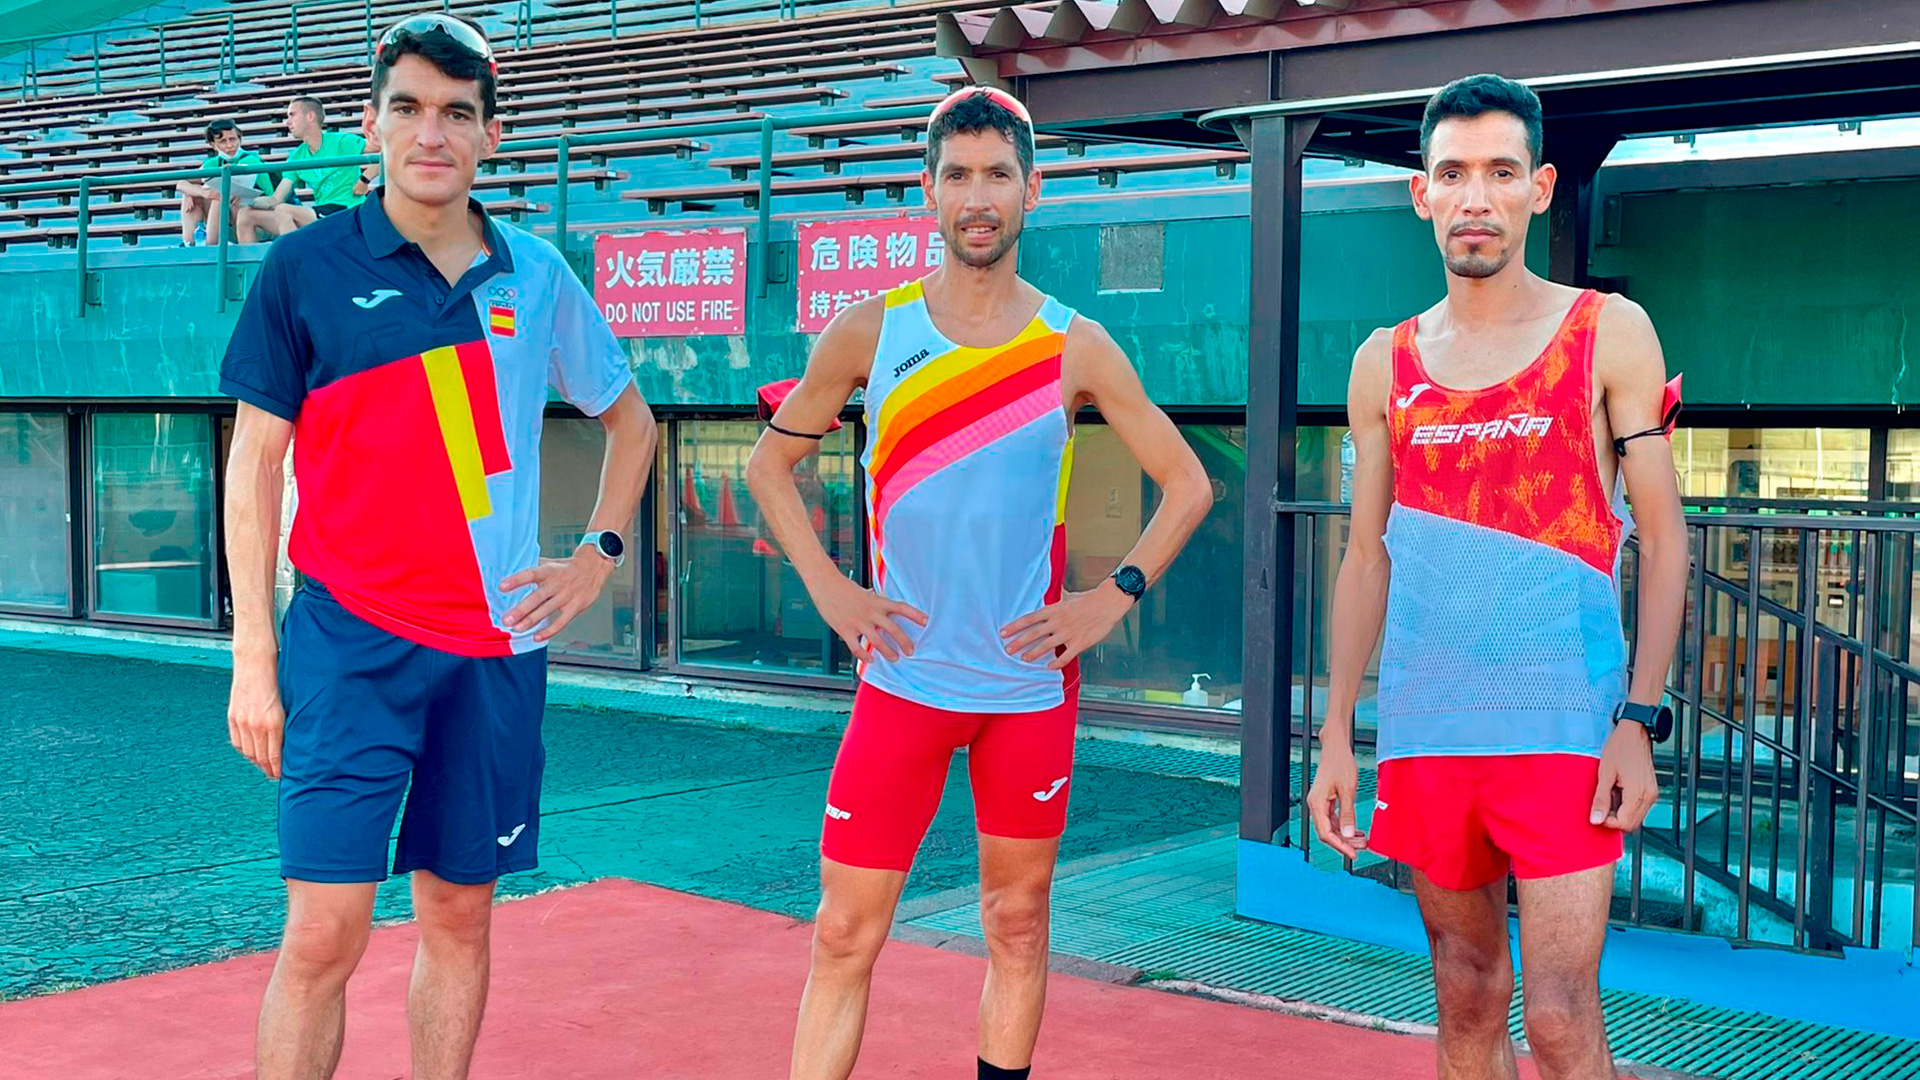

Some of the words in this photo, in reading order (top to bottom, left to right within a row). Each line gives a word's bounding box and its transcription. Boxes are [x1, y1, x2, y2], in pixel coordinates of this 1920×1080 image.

[605, 246, 735, 289] 火気厳禁
[605, 302, 627, 324] DO
[632, 301, 661, 323] NOT
[666, 300, 696, 322] USE
[1411, 413, 1553, 445] ESPAÑA
